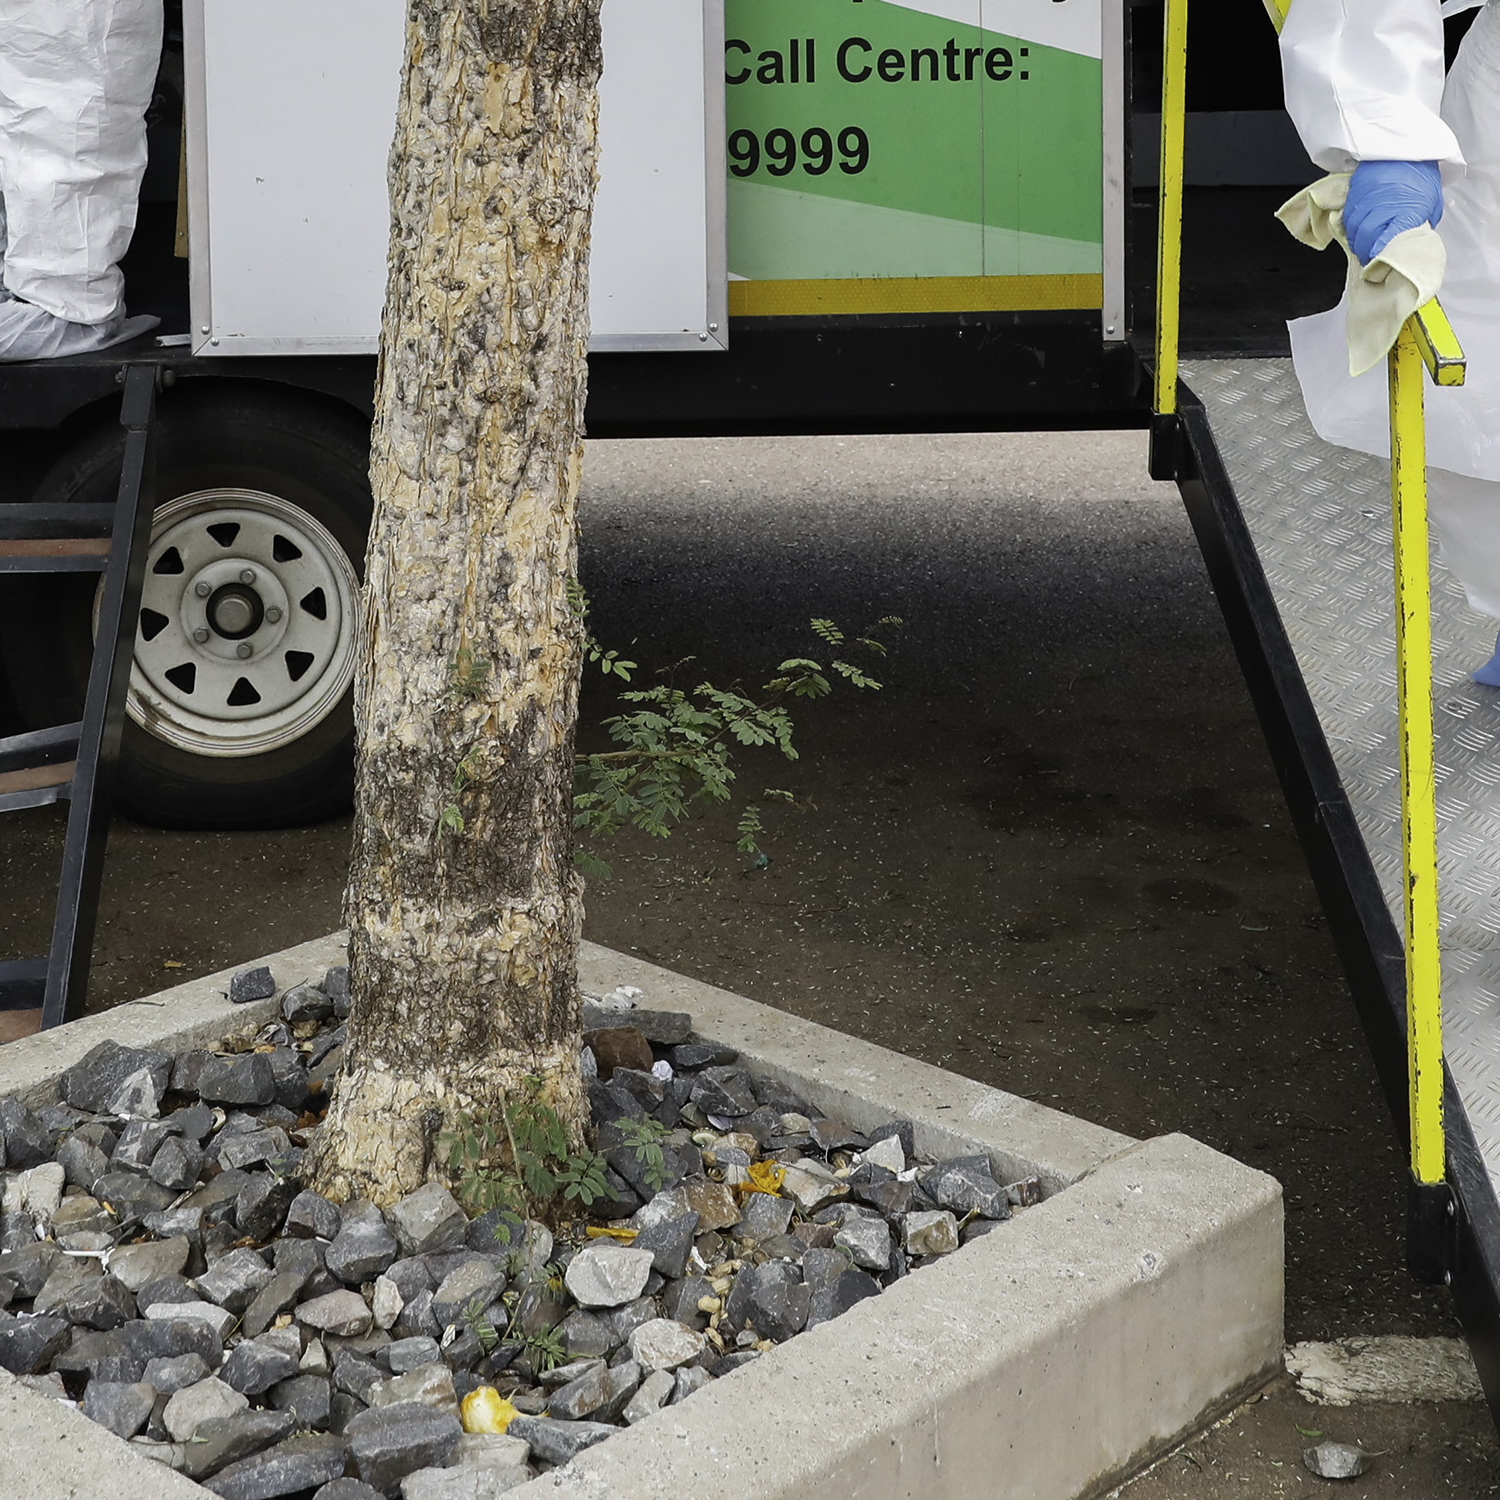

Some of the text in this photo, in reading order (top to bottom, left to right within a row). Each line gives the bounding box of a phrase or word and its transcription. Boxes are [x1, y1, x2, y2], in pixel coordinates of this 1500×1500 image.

[724, 36, 1031, 85] Call Centre:
[727, 126, 871, 178] 9999
